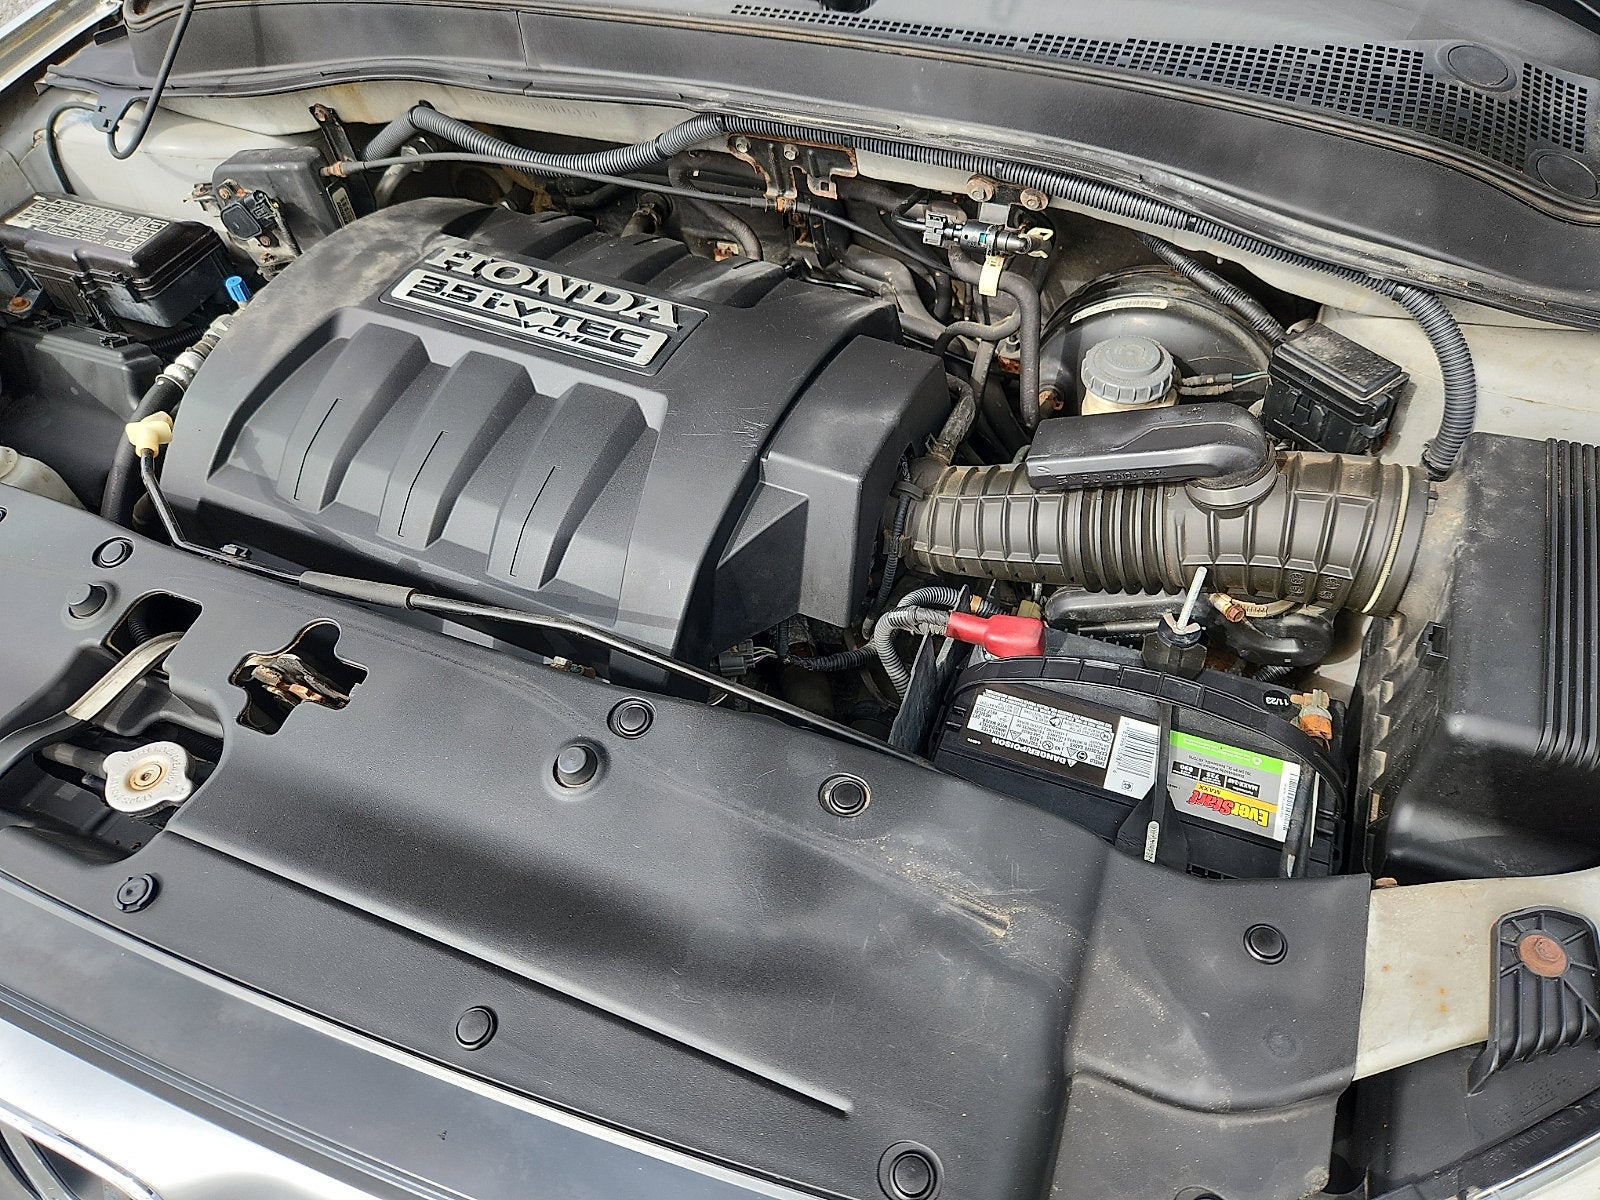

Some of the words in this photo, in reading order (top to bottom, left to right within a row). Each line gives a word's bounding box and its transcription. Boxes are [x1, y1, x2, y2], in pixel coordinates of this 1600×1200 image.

[424, 246, 680, 331] HONDA
[523, 320, 582, 344] VCM
[989, 736, 1068, 765] DANGER/POISON
[1198, 785, 1221, 795] MAXX
[1188, 787, 1270, 828] EverStart
